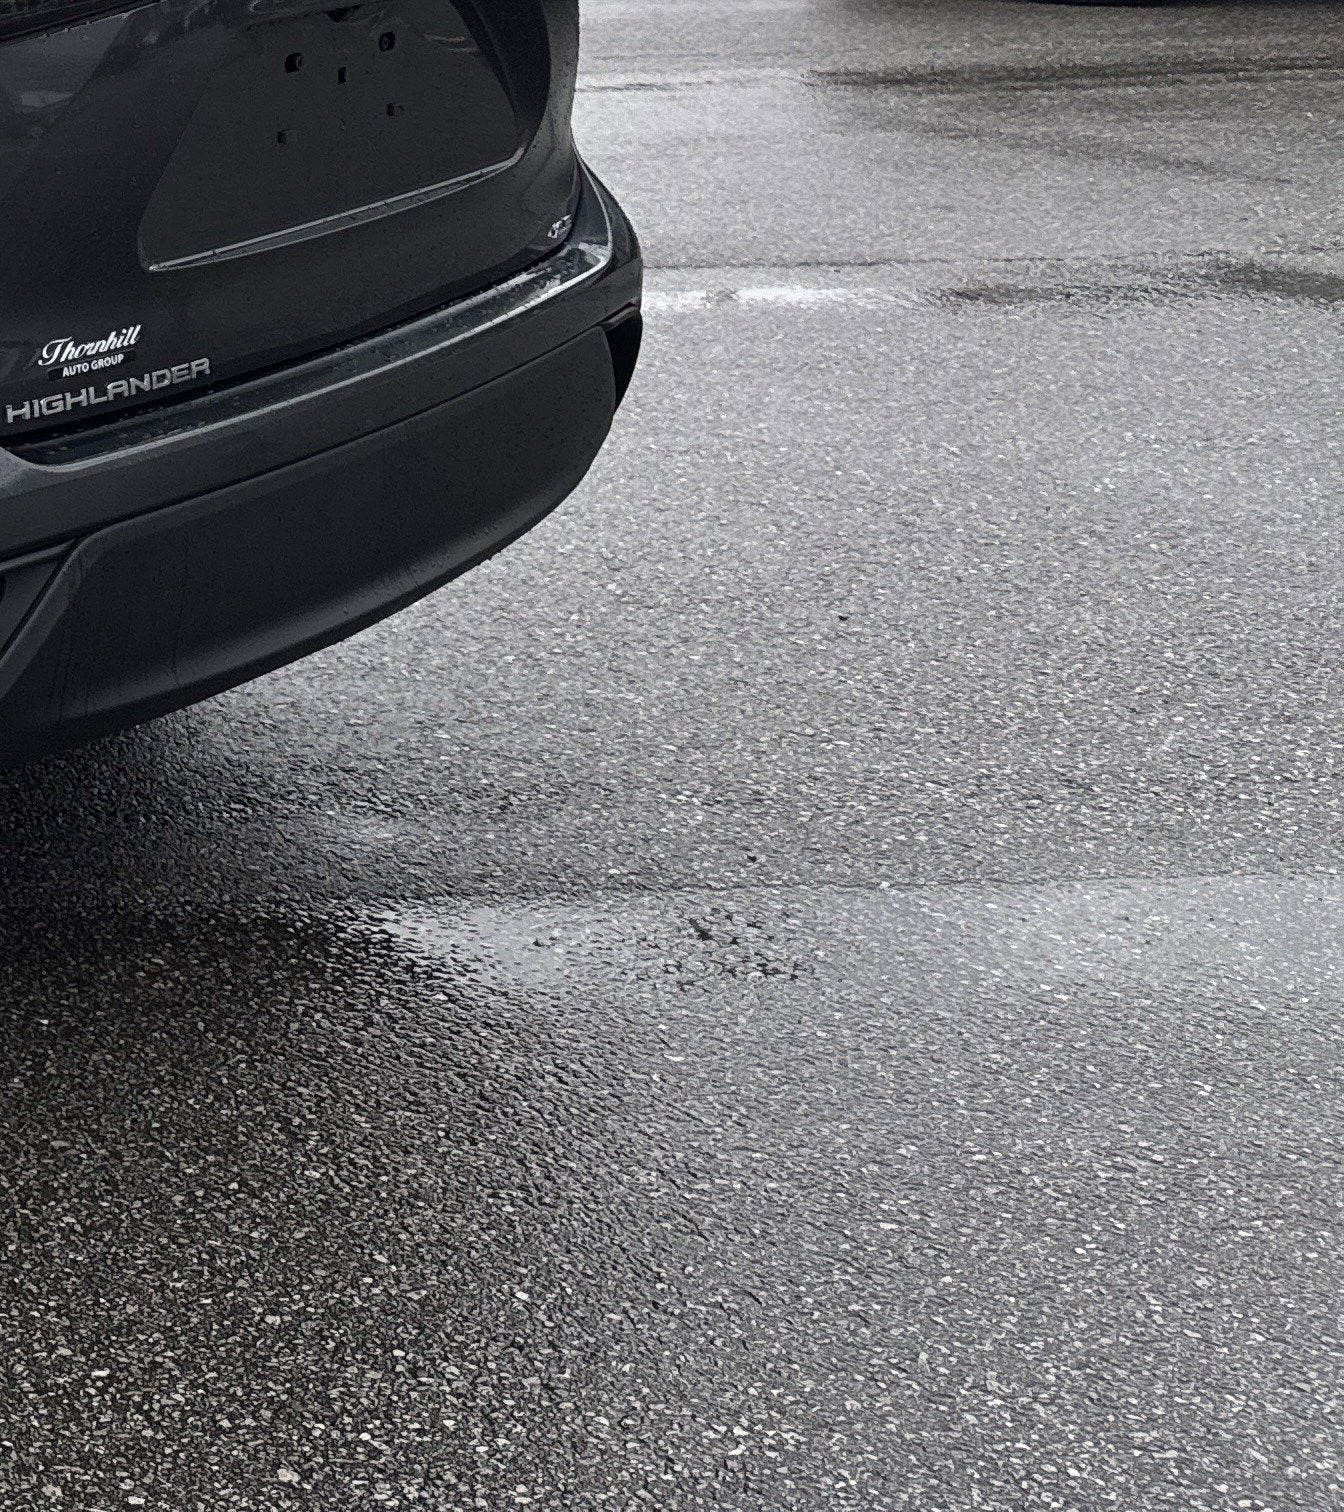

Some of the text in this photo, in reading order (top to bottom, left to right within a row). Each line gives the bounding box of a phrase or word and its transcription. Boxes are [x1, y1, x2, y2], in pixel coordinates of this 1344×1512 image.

[37, 324, 142, 366] Thornhill
[62, 353, 124, 377] AUTO GROUP
[6, 358, 210, 423] HIGHLANDER
